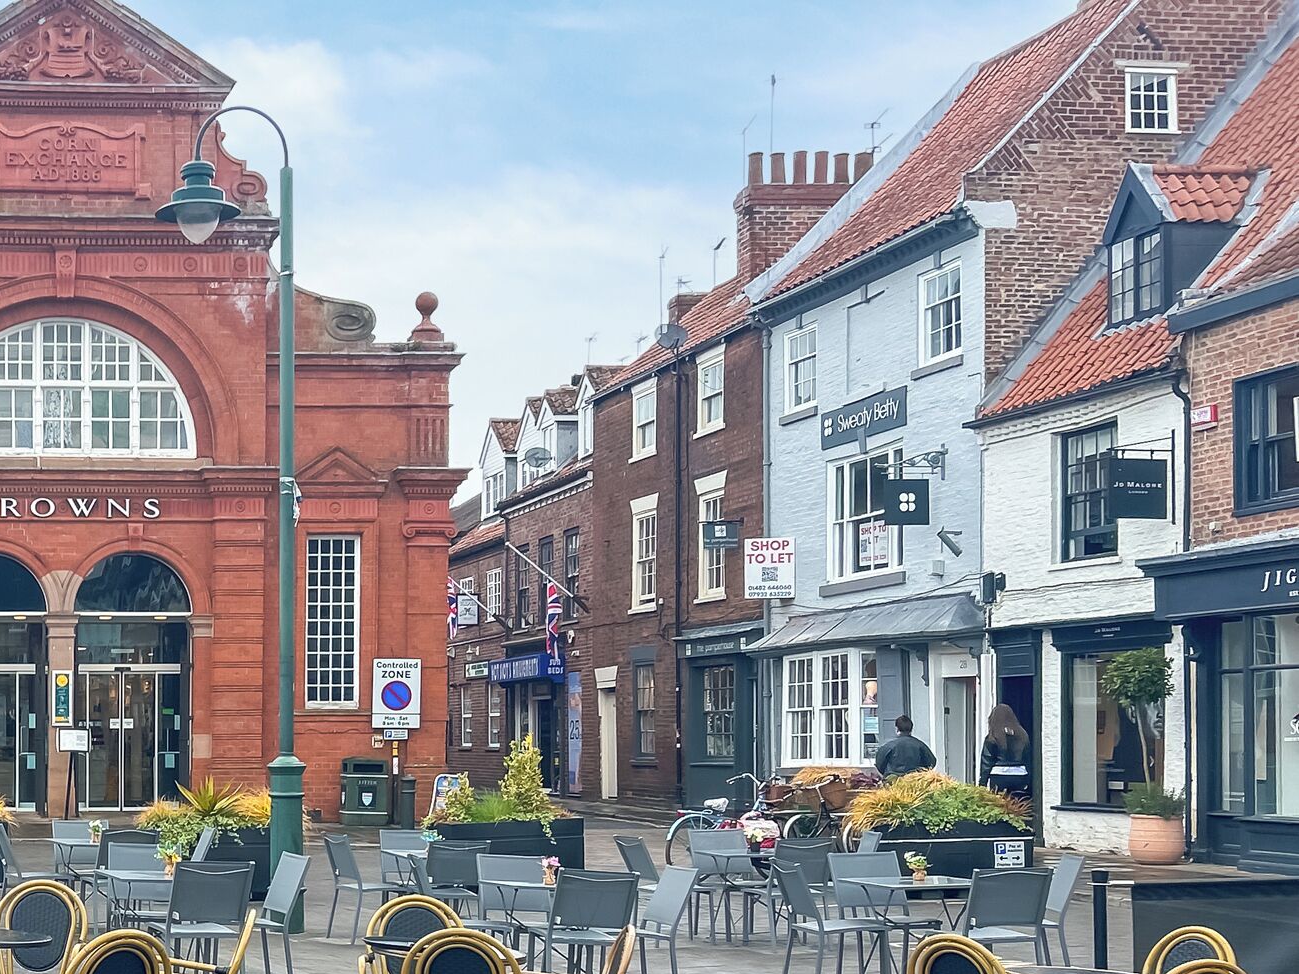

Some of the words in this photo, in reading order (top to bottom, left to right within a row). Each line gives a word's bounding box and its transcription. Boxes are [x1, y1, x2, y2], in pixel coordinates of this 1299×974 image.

[39, 138, 97, 152] CORN
[5, 152, 127, 168] EXCHANGE
[64, 168, 102, 183] 1886
[837, 408, 873, 433] Sweaty
[873, 397, 900, 421] Betty
[750, 540, 790, 552] SHOP
[746, 553, 766, 564] TO
[770, 553, 794, 564] LET
[1261, 568, 1297, 592] JIG
[376, 661, 419, 669] Controlled
[547, 666, 564, 675] BEDS
[381, 670, 411, 679] ZONE
[569, 720, 580, 740] 25
